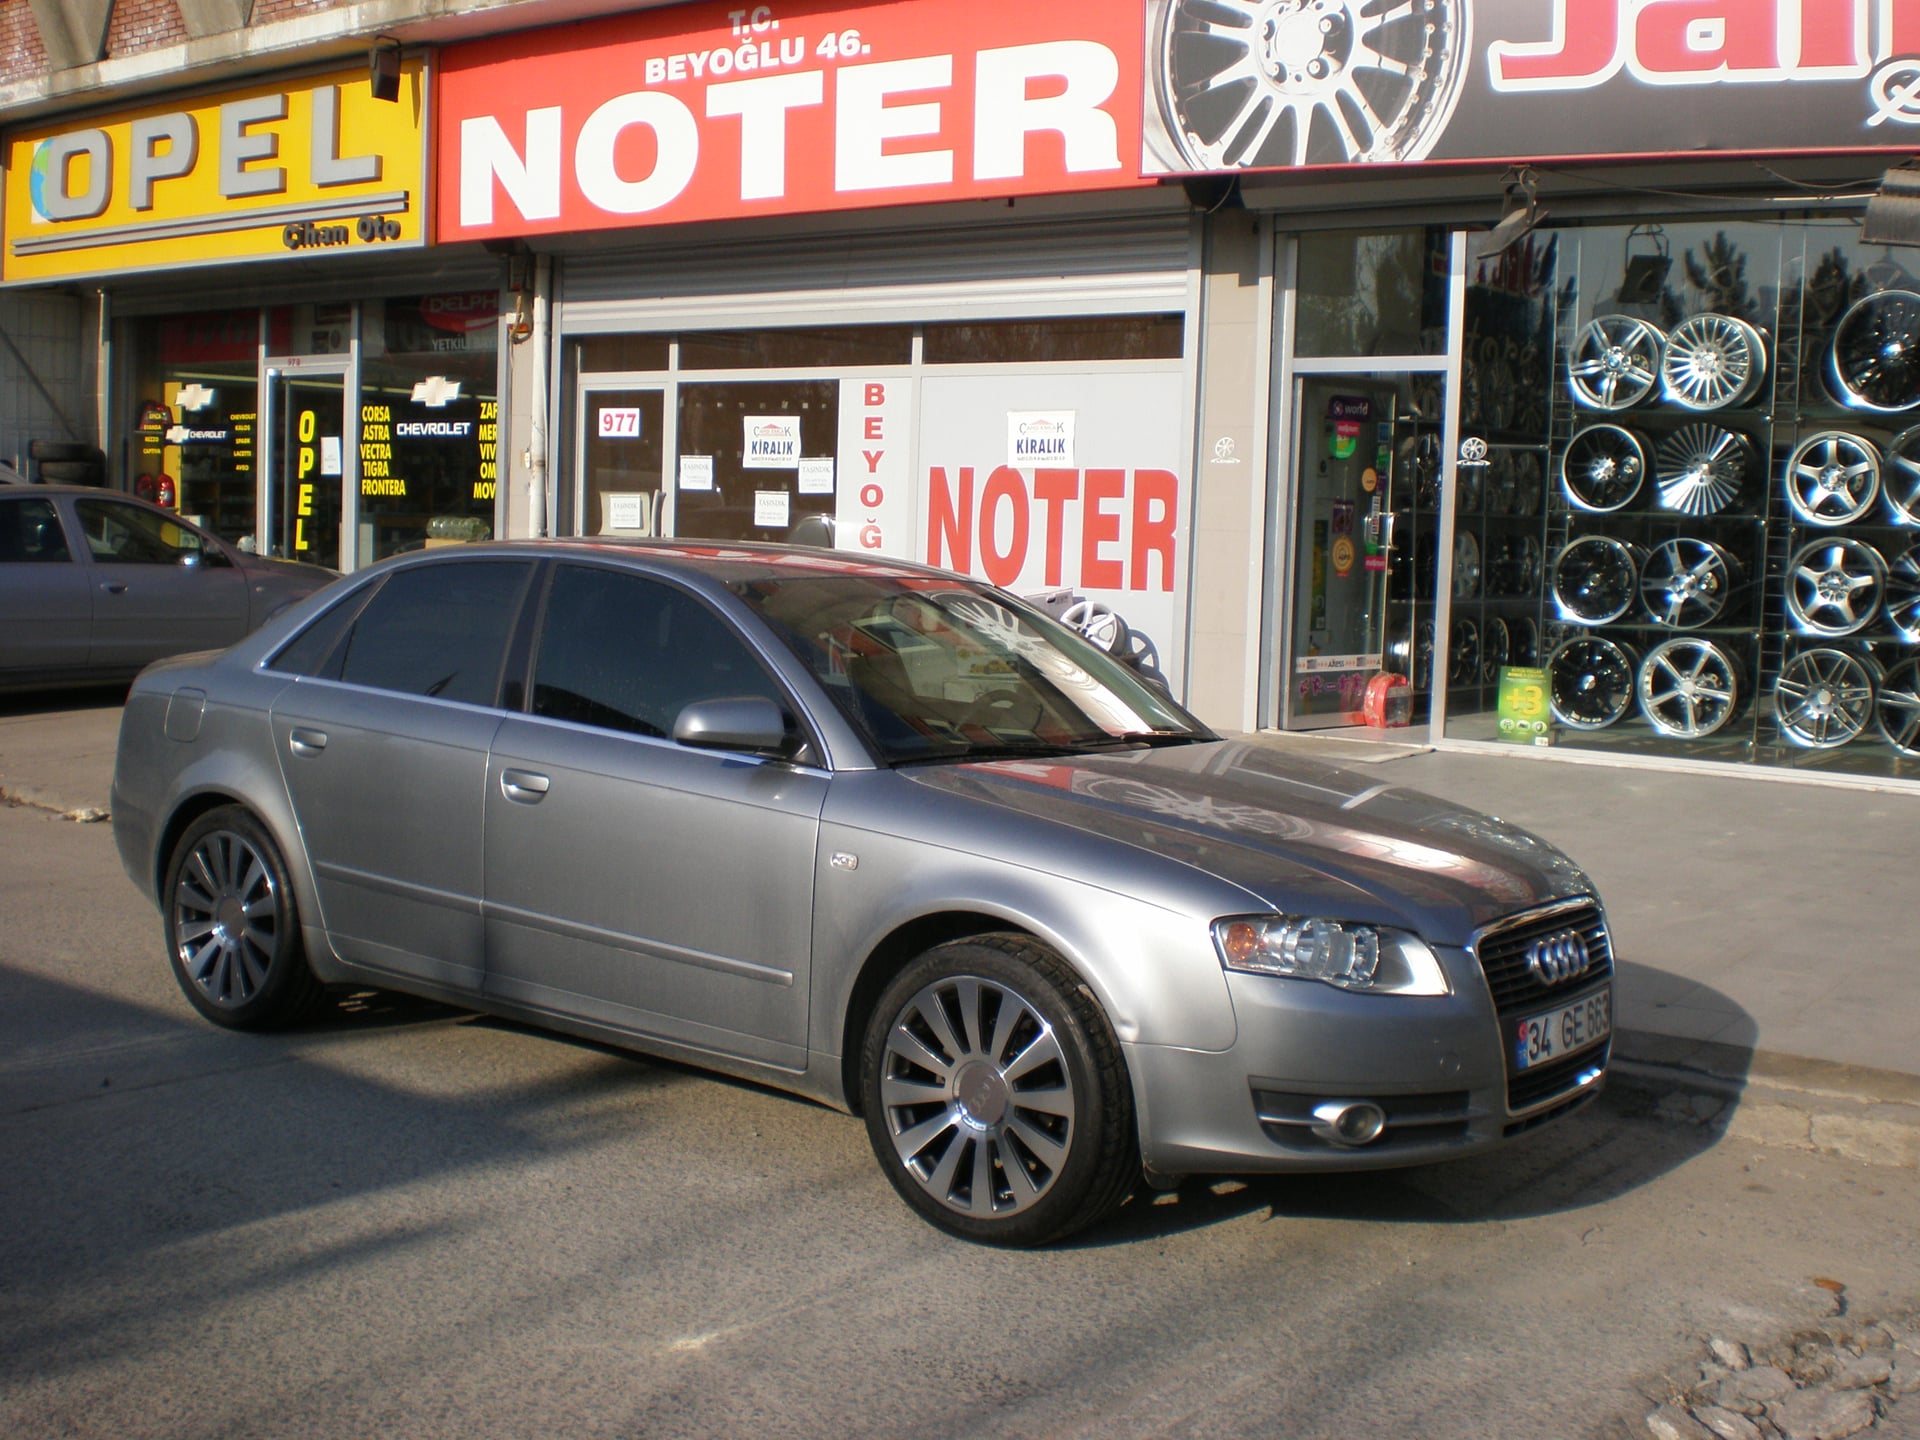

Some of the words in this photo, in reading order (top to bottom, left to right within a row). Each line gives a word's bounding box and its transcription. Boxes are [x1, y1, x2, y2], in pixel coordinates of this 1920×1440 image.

[727, 5, 780, 36] T.C.
[644, 36, 805, 85] BEYOĞLU
[815, 29, 871, 59] 46.
[460, 39, 1122, 227] NOTER
[46, 84, 383, 222] OPEL
[356, 214, 401, 243] Oto
[230, 413, 257, 421] CHEVROLET
[361, 405, 391, 422] CORSA
[1345, 402, 1369, 416] world
[396, 422, 471, 436] CHEVROLET
[603, 413, 637, 432] 977
[189, 430, 227, 439] CHEVROLET
[362, 424, 391, 441] ASTRA
[360, 443, 392, 460] VECTRA
[751, 439, 794, 456] KİRALIK
[1016, 436, 1066, 455] KİRALIK
[363, 460, 389, 477] TIGRA
[295, 409, 315, 550] OPEL
[361, 479, 406, 496] FRONTERA
[926, 464, 1179, 593] NOTER
[1528, 1016, 1552, 1061] 34
[1561, 1004, 1585, 1050] GE
